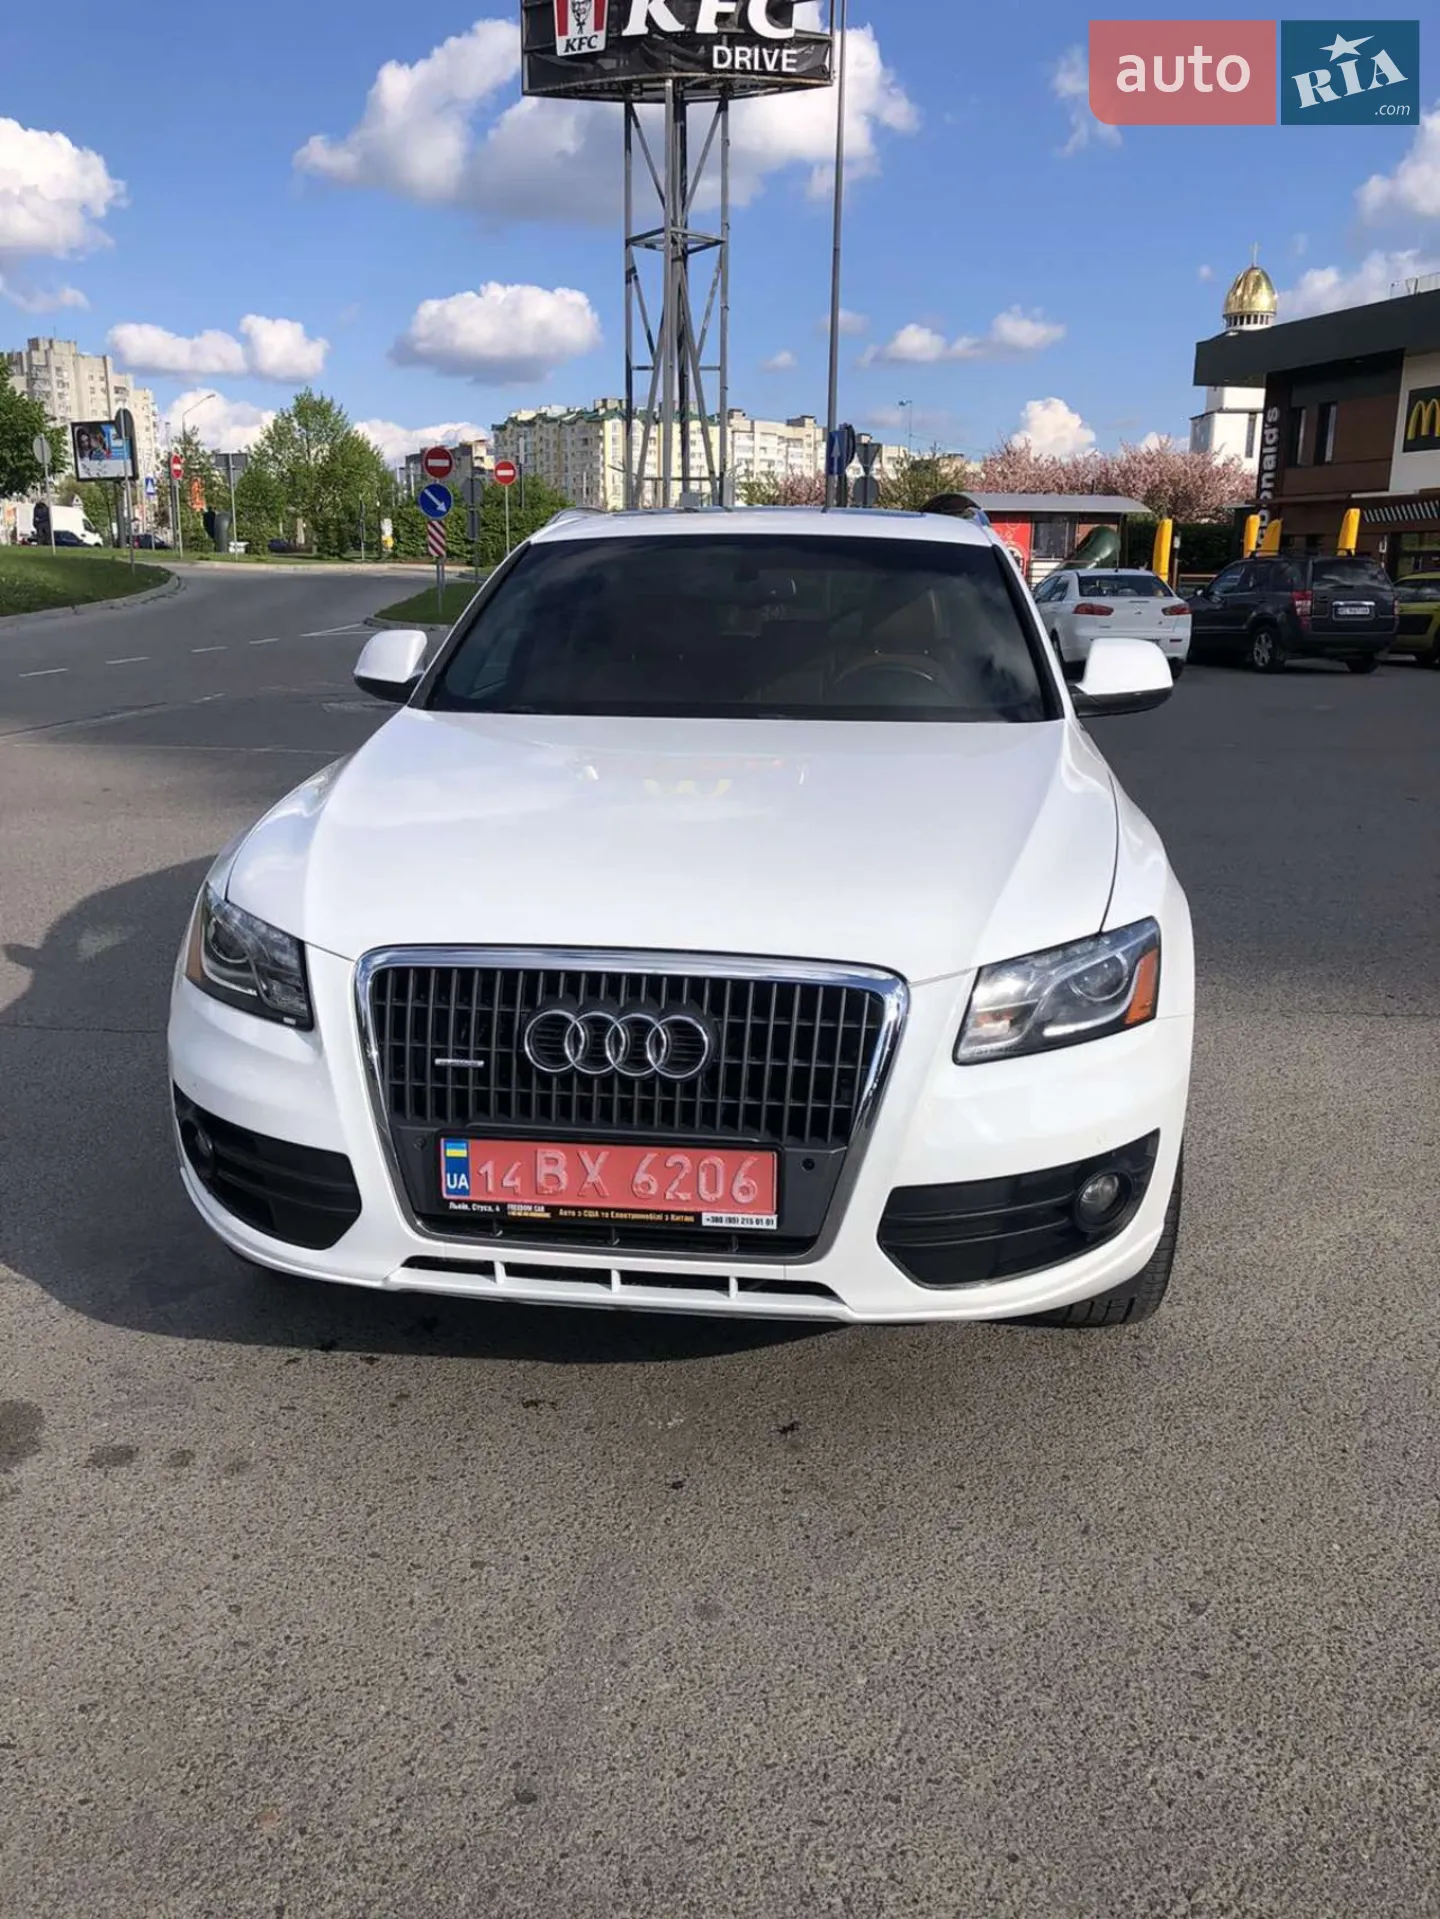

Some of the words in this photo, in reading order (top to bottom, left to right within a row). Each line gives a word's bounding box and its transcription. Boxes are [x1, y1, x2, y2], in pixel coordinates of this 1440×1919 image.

[564, 34, 598, 53] KFC
[713, 46, 797, 72] DRIVE
[446, 1172, 469, 1190] UA
[477, 1160, 523, 1194] 14
[631, 1151, 759, 1204] 6206
